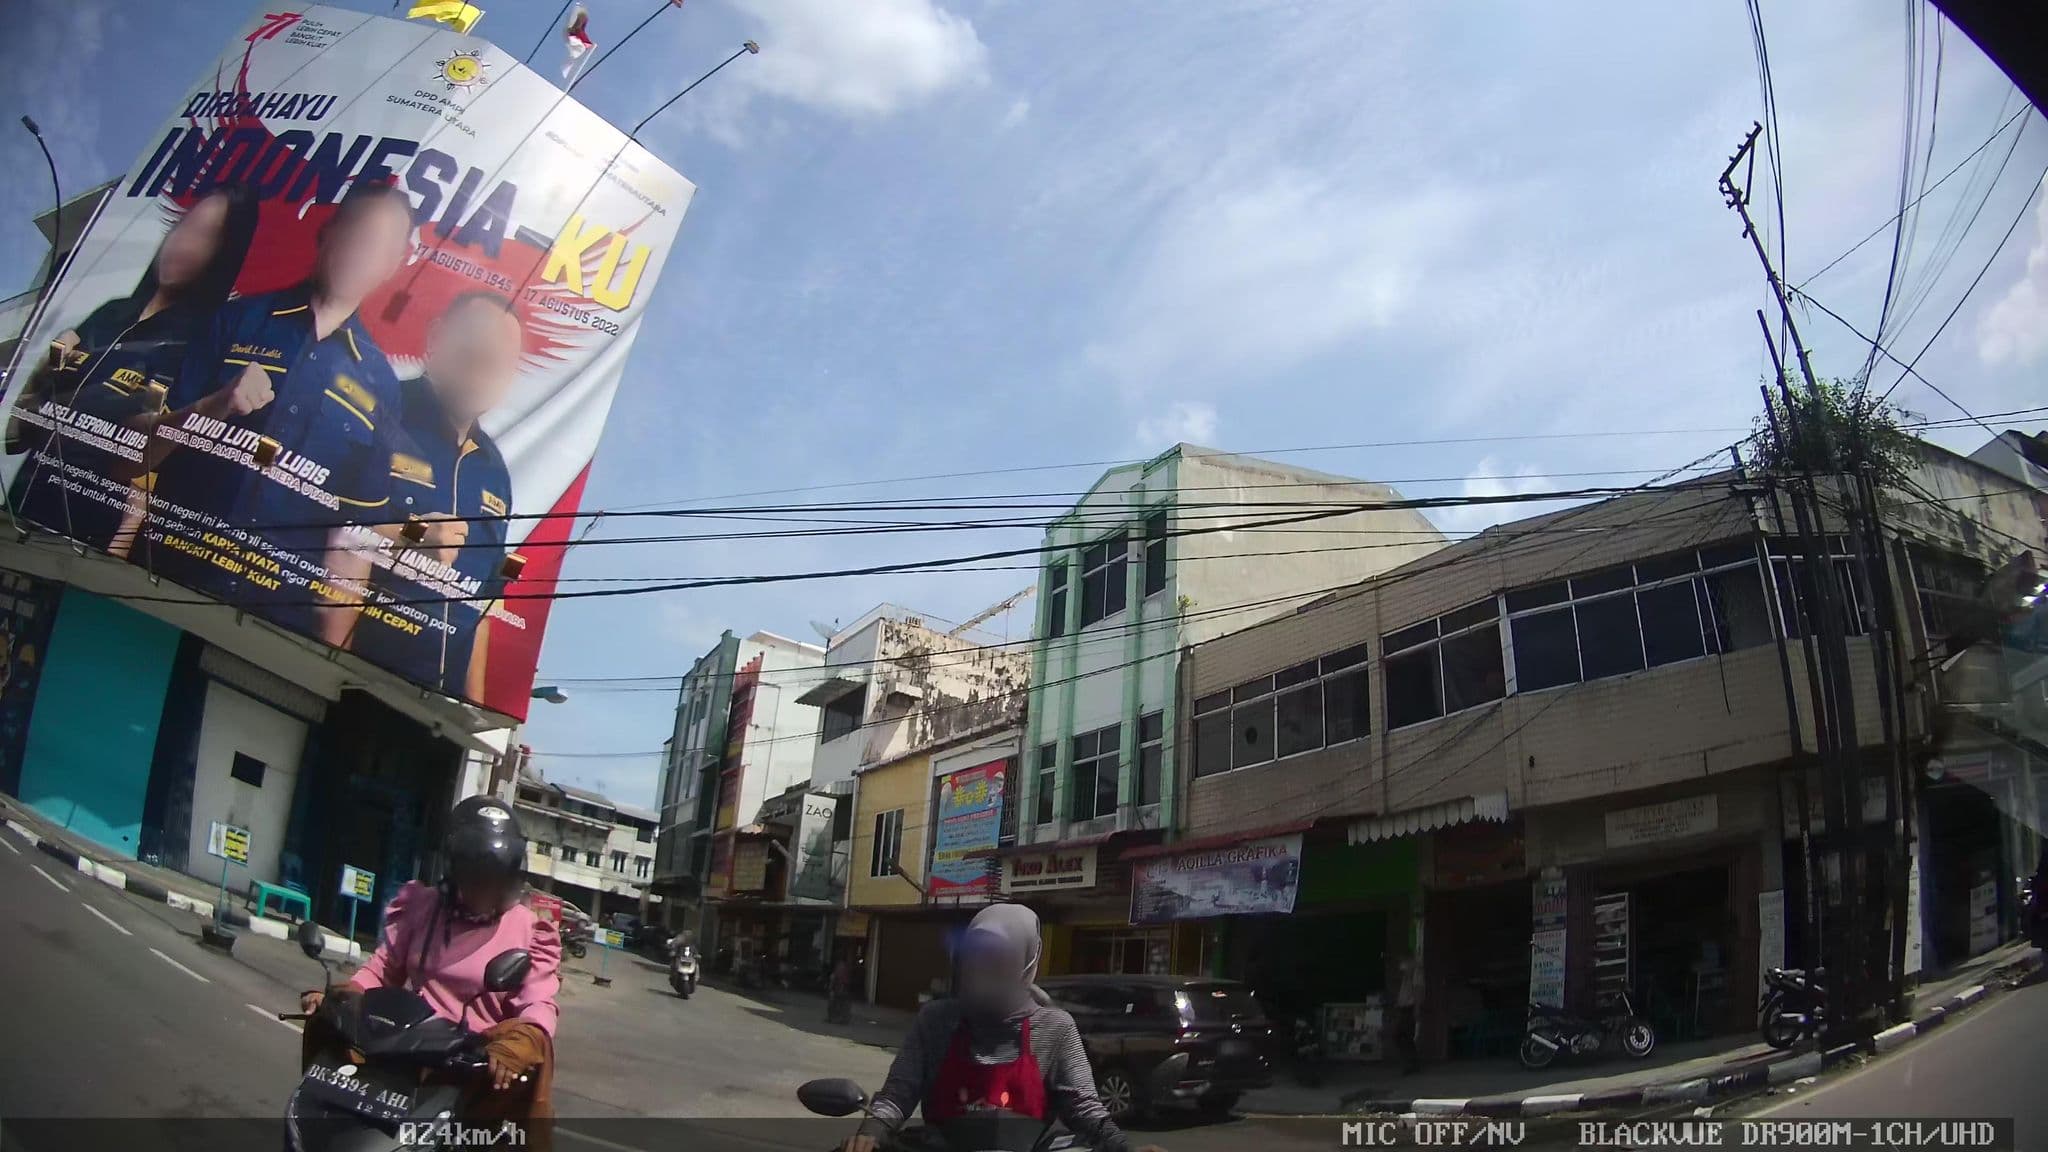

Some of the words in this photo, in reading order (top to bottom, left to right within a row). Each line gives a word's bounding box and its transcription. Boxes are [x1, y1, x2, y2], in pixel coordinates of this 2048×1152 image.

[180, 91, 338, 121] DIRGAHAYU
[386, 95, 443, 117] SUMATERA
[444, 113, 478, 139] UTARA
[414, 90, 438, 102] DPD
[414, 242, 428, 256] 17
[431, 252, 484, 281] AGUSTUS
[485, 272, 514, 293] 1945
[522, 288, 537, 302] 17
[539, 297, 591, 324] AGUSTUS
[590, 316, 620, 337] 2022
[75, 413, 117, 439] SEPRINA
[115, 427, 149, 450] LUBIS
[183, 413, 227, 439] DAVID
[278, 450, 331, 486] LUBIS
[156, 425, 189, 444] KETUA
[189, 436, 214, 452] DPD
[213, 443, 242, 462] AMPI
[240, 452, 301, 492] SUATERA
[301, 481, 341, 511] UTARA
[82, 486, 108, 504] untuk
[202, 532, 241, 556] KARYA
[280, 567, 311, 588] agar
[382, 611, 424, 636] CEPAT
[99, 476, 129, 495] segera
[170, 502, 203, 522] negeri
[202, 512, 218, 527] ini
[428, 616, 458, 636] para
[163, 534, 214, 561] BANGKIT
[245, 568, 282, 592] KUAT
[806, 804, 833, 819] ZAO
[1177, 855, 1223, 872] AQILLA
[1226, 844, 1288, 864] GRAFIKA
[308, 1064, 331, 1082] BK
[327, 1071, 371, 1097] 3394
[375, 1089, 409, 1111] AHL
